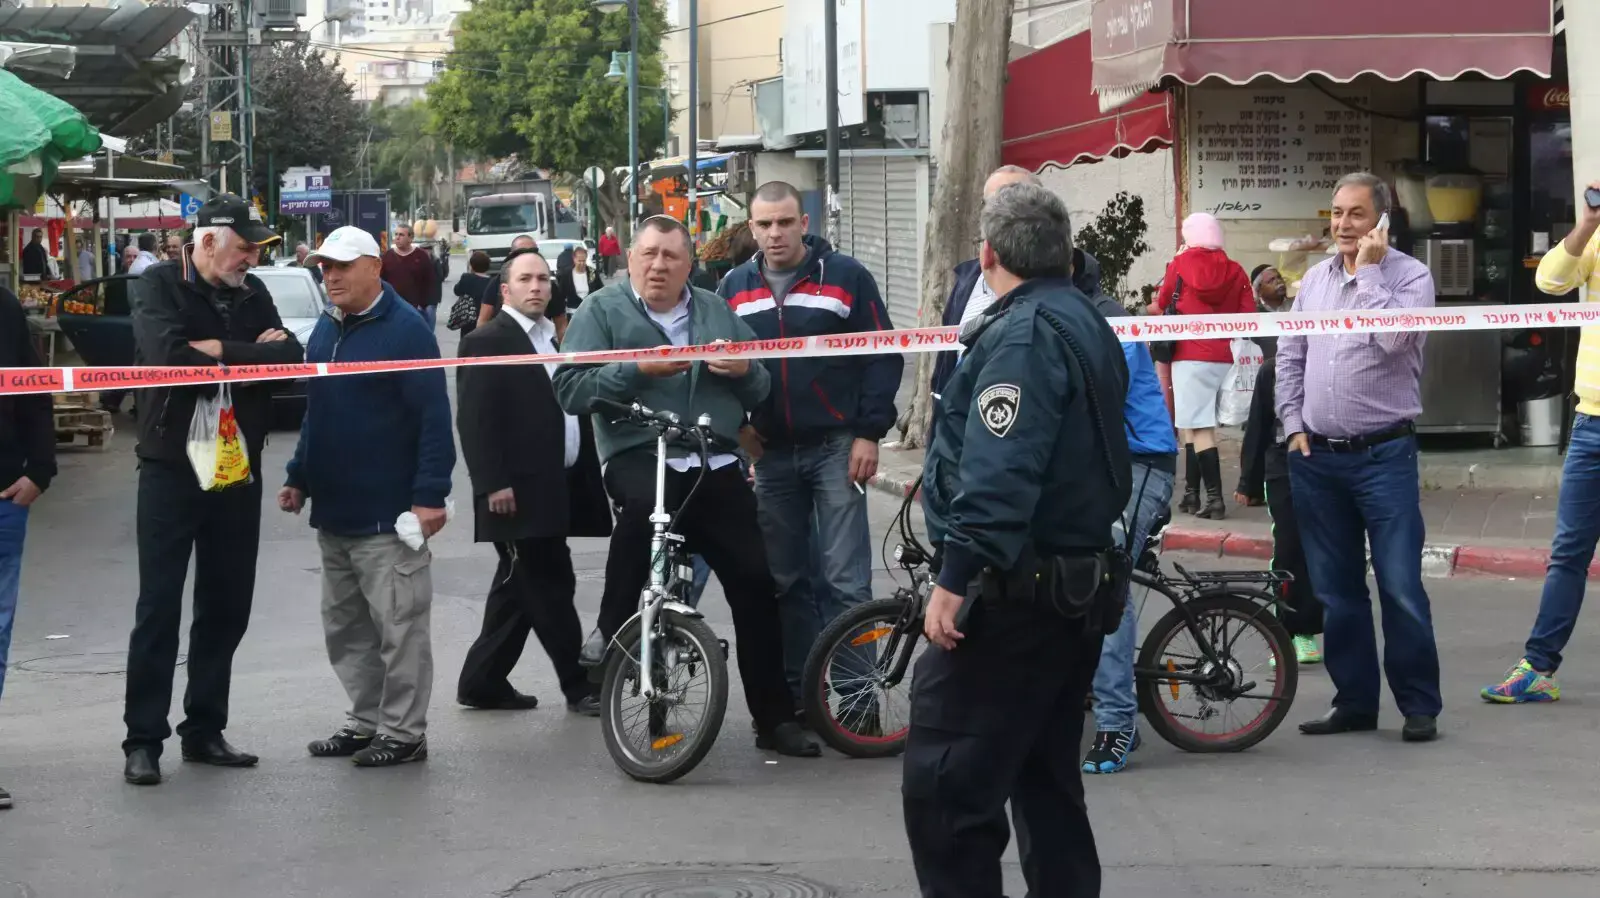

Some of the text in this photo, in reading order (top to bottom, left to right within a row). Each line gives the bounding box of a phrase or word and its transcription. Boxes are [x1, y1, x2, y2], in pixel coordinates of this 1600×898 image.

[1198, 165, 1204, 175] 3
[1198, 179, 1204, 189] 3
[288, 201, 309, 210] לחניון
[1356, 314, 1466, 328] משטרת ישראל
[1483, 313, 1520, 325] מעבר
[1525, 311, 1542, 325] אין
[1144, 320, 1189, 334] ישראל
[1205, 320, 1258, 332] משטרת
[1275, 318, 1340, 332] אין מעבר
[824, 332, 957, 350] שראל אין מעבר
